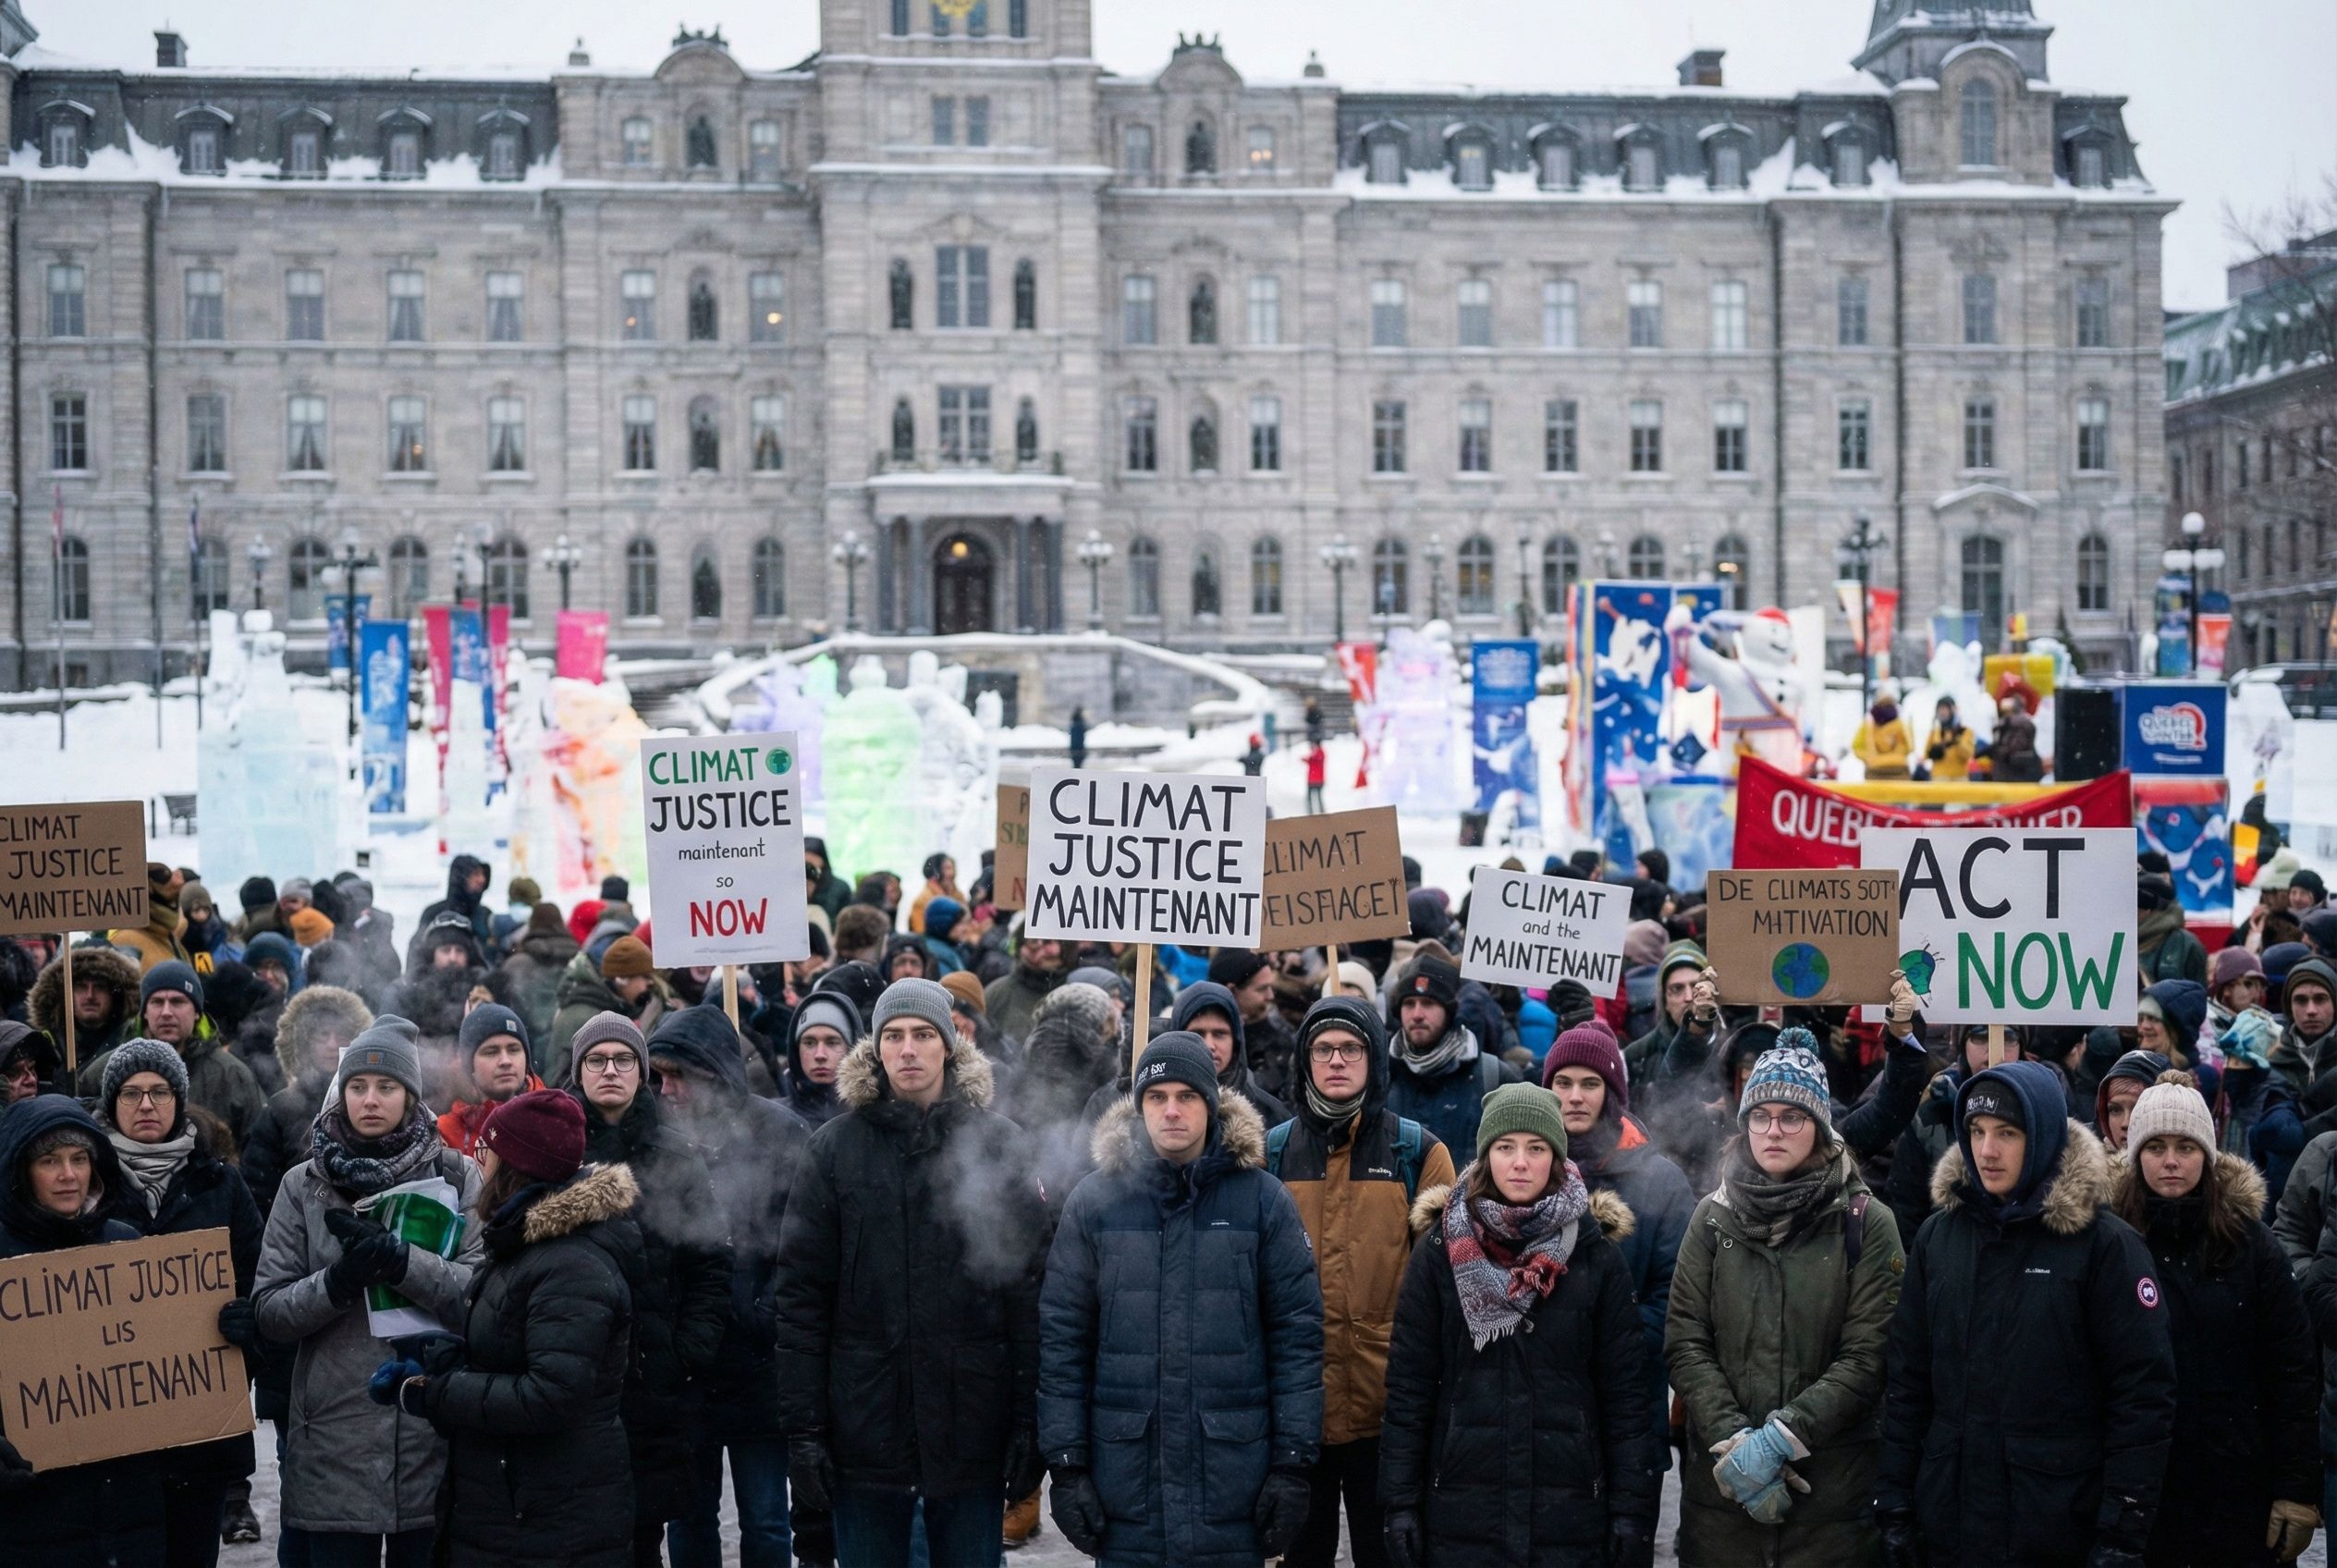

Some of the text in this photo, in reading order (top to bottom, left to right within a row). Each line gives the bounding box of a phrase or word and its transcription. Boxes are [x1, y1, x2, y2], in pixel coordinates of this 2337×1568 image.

[649, 747, 759, 785] CLIMAT
[650, 790, 791, 832] JUSTICE
[1050, 778, 1247, 832] CLIMAT
[0, 815, 81, 843] CLIMAT
[8, 847, 124, 879] JUSTICE
[679, 837, 765, 861] maintenant
[1048, 833, 1243, 884] JUSTICE
[716, 876, 734, 888] so
[1719, 878, 1754, 900] DE
[1768, 878, 1850, 900] CLIMATS
[1900, 836, 2086, 919] ACT
[0, 887, 145, 920] MAINTENANT
[690, 898, 768, 937] NOW
[1032, 884, 1260, 937] MAINTENANT
[1501, 880, 1607, 920] CLIMAT
[1523, 920, 1581, 939] and the
[1469, 935, 1621, 984] MAINTENANT
[1958, 932, 2125, 1010] NOW
